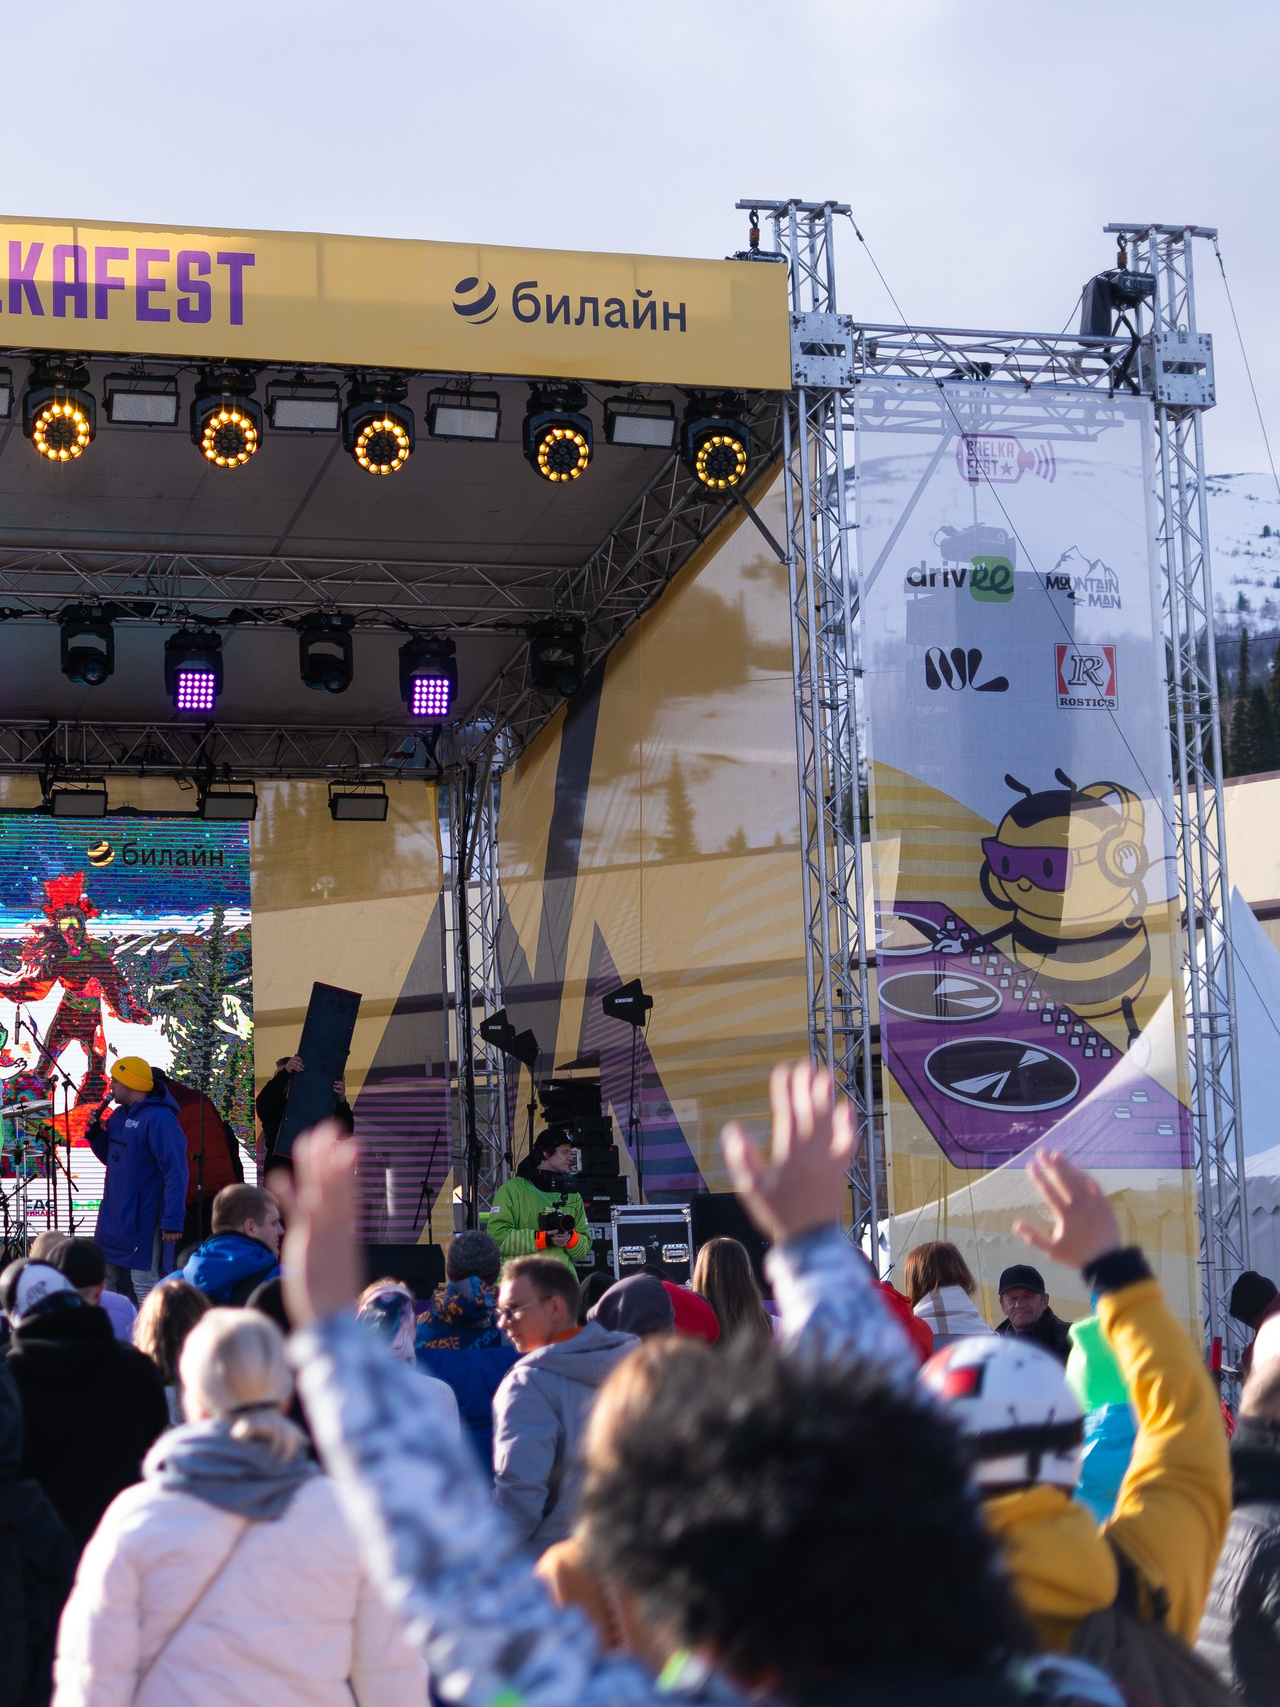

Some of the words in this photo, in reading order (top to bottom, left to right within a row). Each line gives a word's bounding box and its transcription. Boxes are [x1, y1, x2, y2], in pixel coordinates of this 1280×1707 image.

[512, 280, 687, 332] билайн
[967, 440, 1015, 458] GRELKA
[967, 459, 998, 475] FEST
[906, 561, 1014, 594] drivee
[1046, 575, 1119, 593] MOUNTAIN
[1088, 593, 1121, 609] MAN
[1060, 698, 1115, 707] ROSTIC'S
[122, 841, 223, 867] билайн
